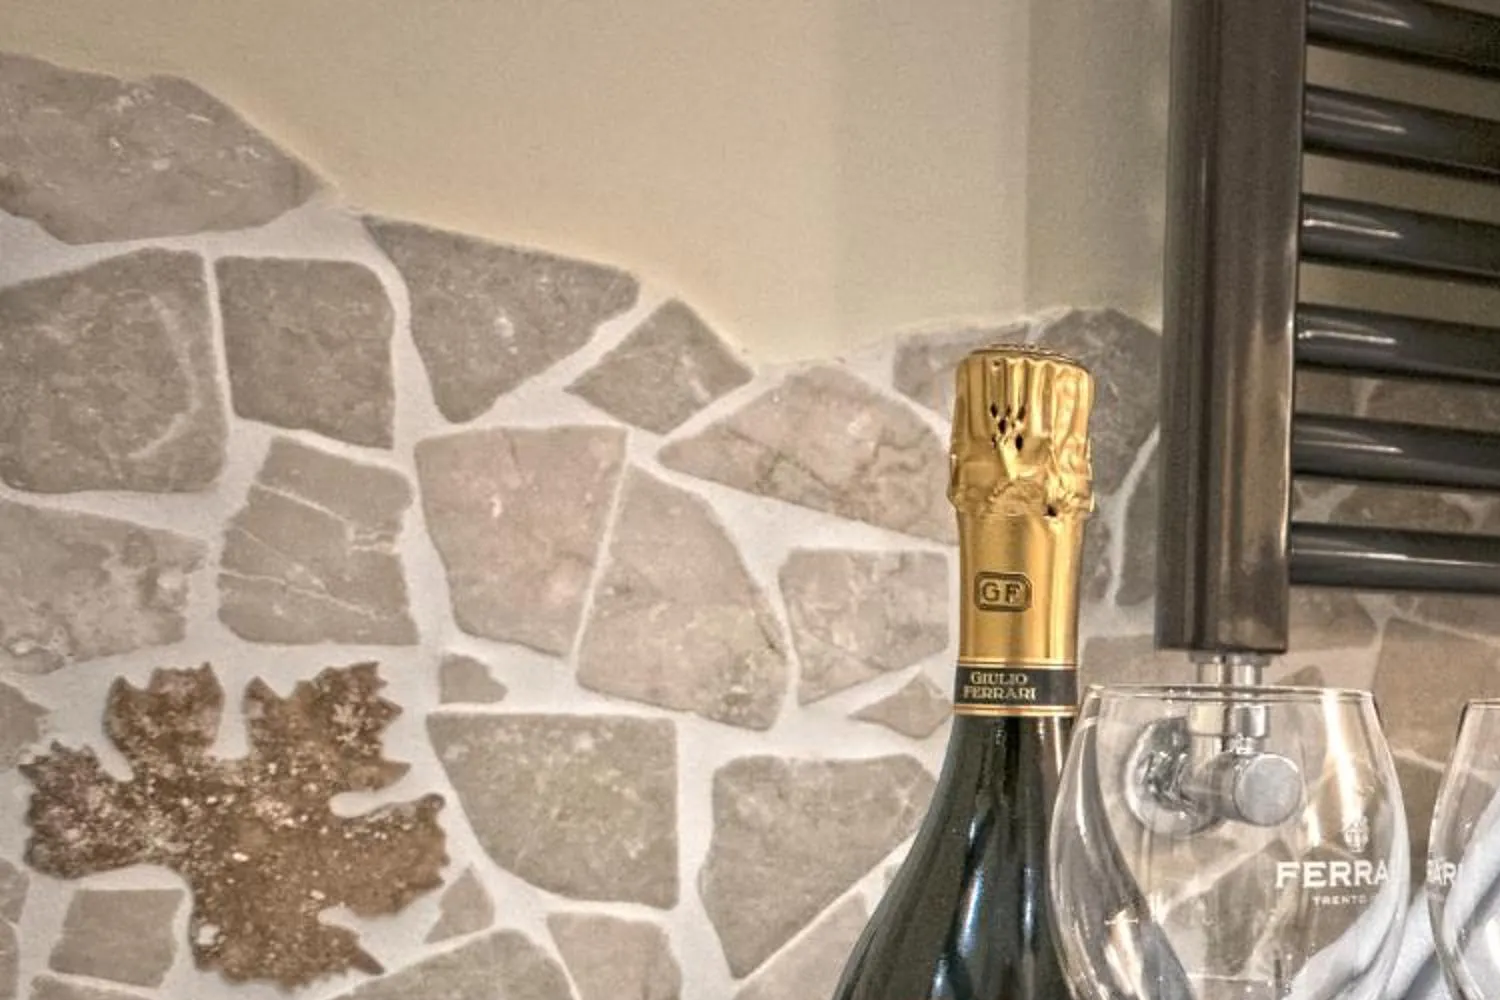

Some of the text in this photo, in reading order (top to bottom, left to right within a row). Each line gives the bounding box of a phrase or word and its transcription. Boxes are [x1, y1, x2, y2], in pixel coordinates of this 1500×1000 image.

[982, 582, 1020, 603] GF
[970, 671, 1028, 685] GIULIO
[963, 685, 1036, 700] FERRARI
[1275, 859, 1389, 887] FERRA
